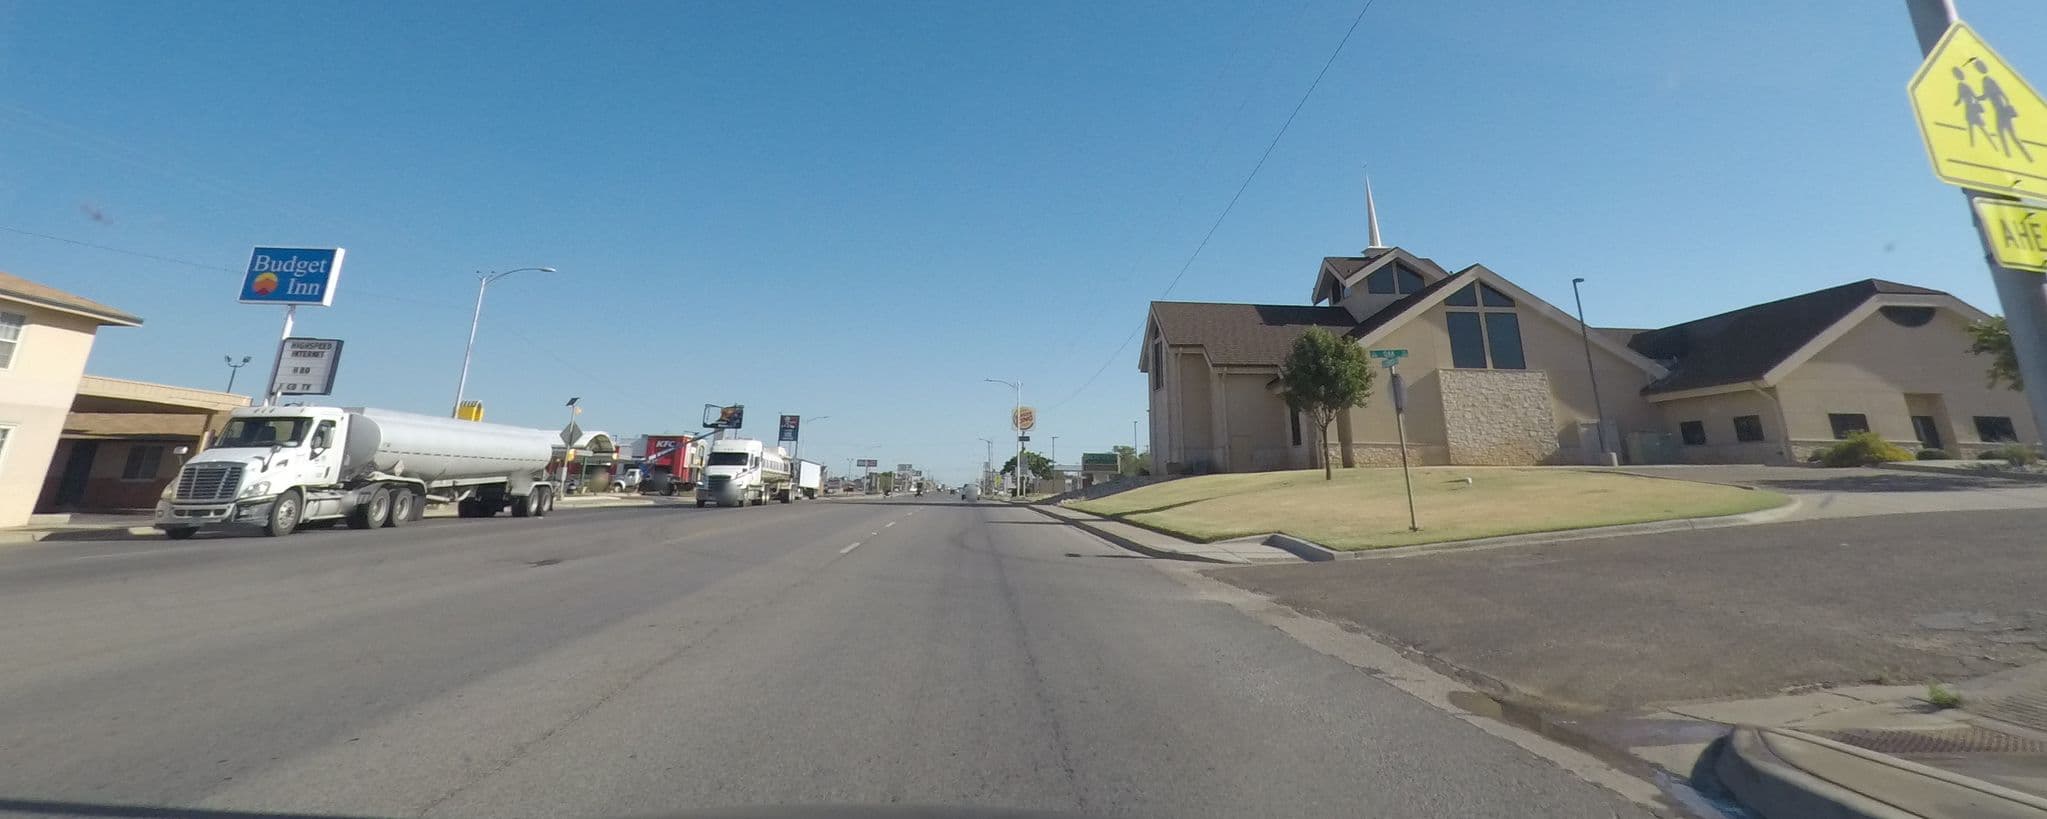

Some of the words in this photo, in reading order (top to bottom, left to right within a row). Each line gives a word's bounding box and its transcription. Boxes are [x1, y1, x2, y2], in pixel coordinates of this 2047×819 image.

[253, 255, 327, 276] Budget
[287, 278, 320, 295] Inn
[291, 342, 333, 350] HIGHSPEED
[291, 350, 325, 358] INTERNET
[655, 440, 676, 448] KFC
